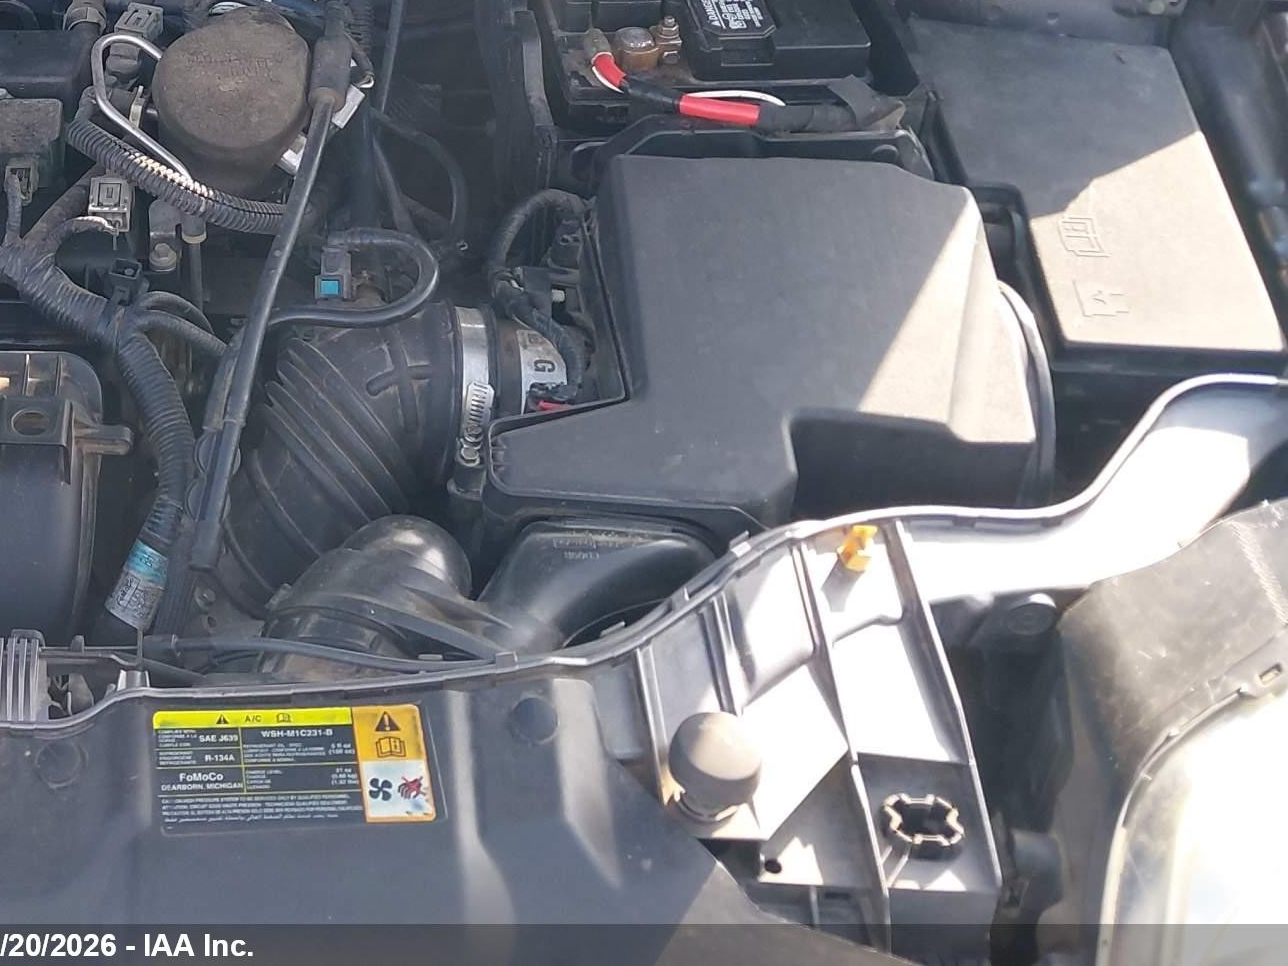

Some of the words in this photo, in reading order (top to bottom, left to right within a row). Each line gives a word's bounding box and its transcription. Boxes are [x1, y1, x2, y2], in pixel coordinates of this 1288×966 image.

[244, 714, 262, 723] A/C
[199, 734, 217, 743] SAE
[218, 734, 239, 742] J639
[204, 754, 236, 763] R-134A
[179, 772, 224, 782] FoMoCo
[206, 782, 244, 790] MICHIGAN
